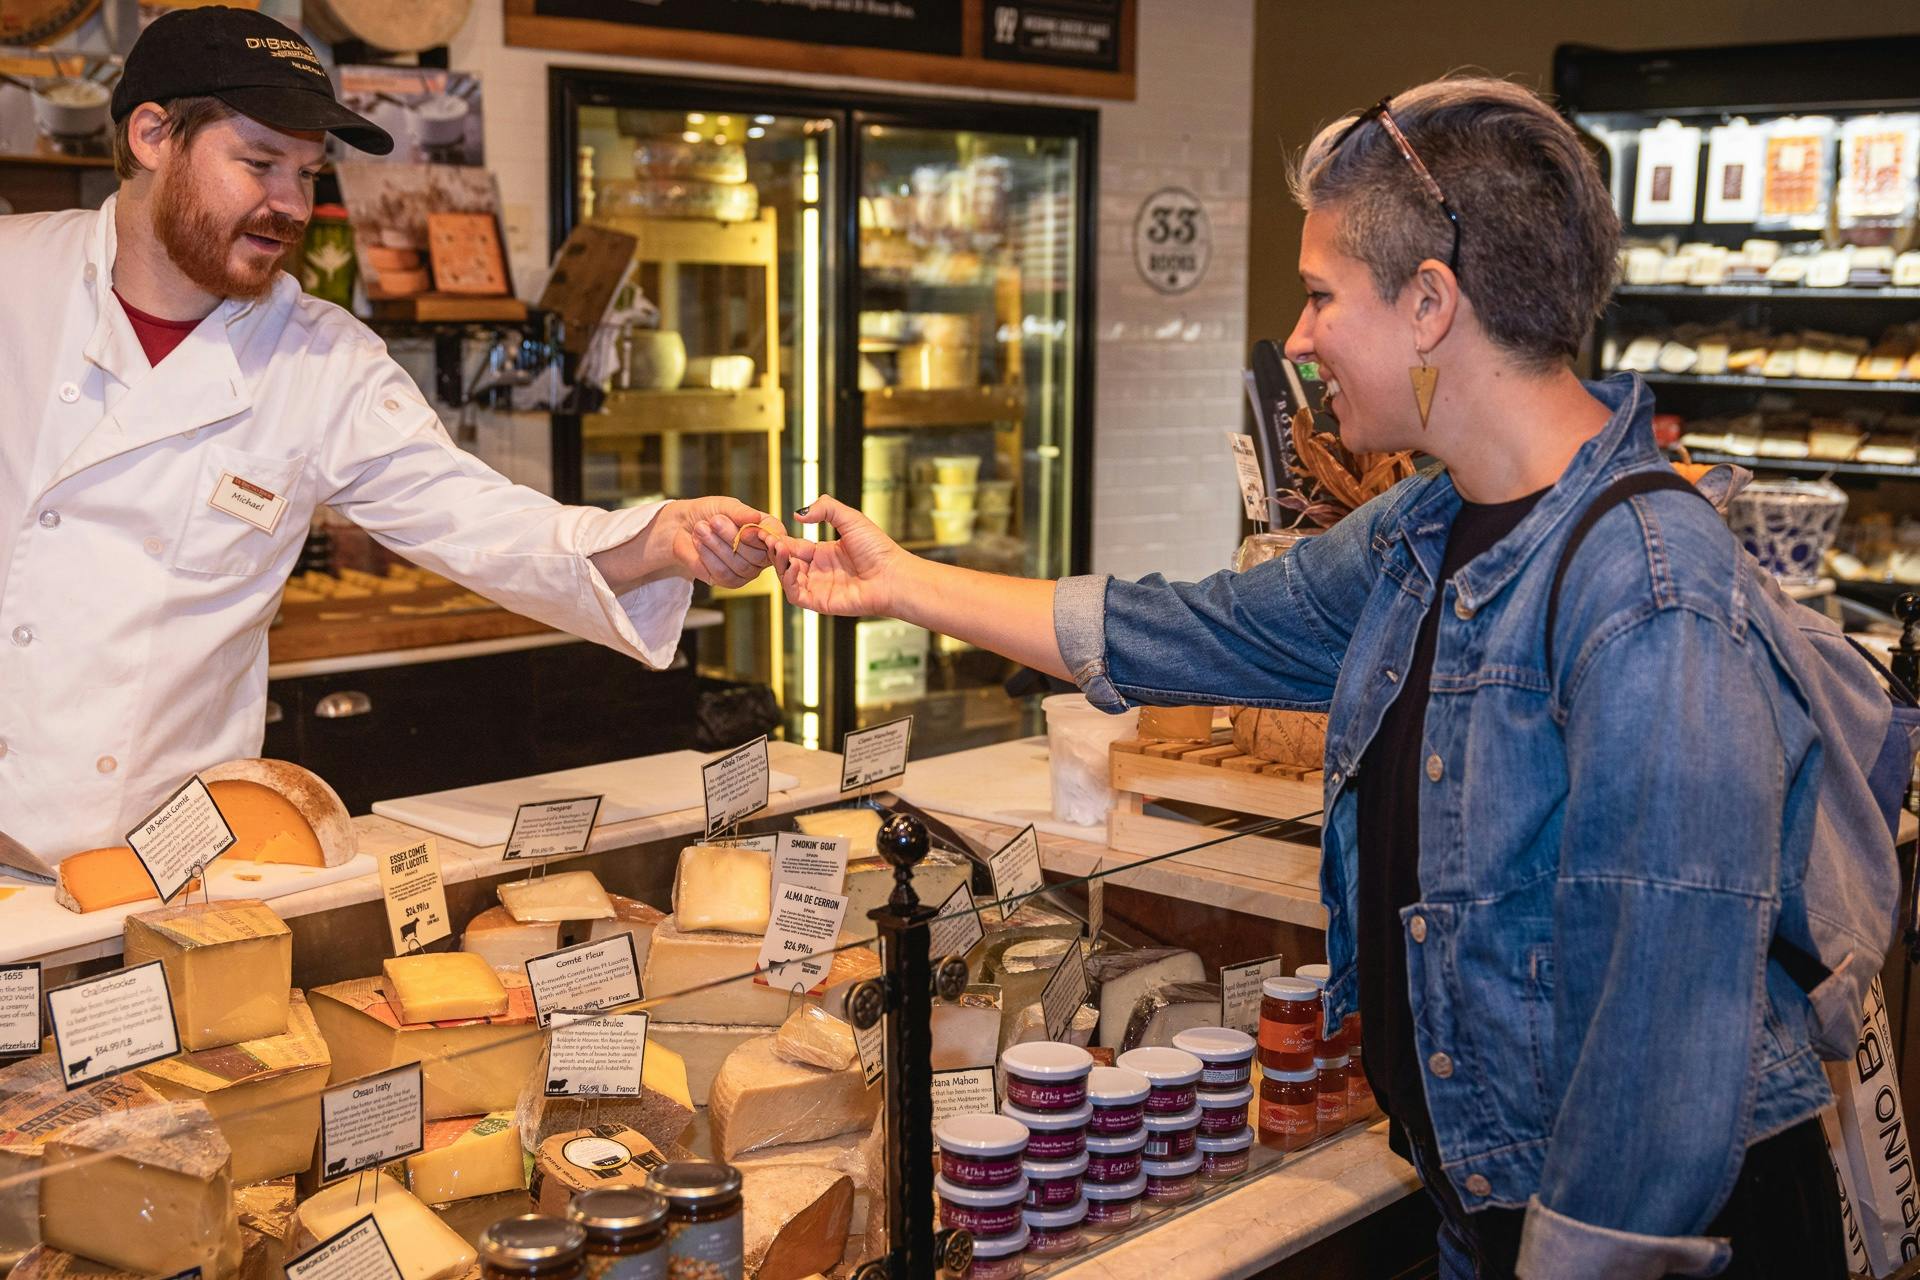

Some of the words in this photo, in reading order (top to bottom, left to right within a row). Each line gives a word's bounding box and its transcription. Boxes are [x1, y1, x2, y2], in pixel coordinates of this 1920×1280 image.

[1147, 206, 1201, 245] 33
[231, 492, 265, 511] Michael
[145, 823, 155, 835] DB
[154, 809, 171, 827] Select
[170, 793, 189, 813] Comté
[212, 834, 229, 851] France
[791, 839, 820, 850] SMOKIN'
[820, 842, 837, 851] GOAT
[389, 851, 407, 864] ESSEX
[390, 862, 404, 875] FORT
[405, 853, 428, 869] LUCOTTE
[784, 889, 803, 902] ALMA
[803, 894, 813, 904] DE
[784, 939, 812, 954] $24.99/LB
[556, 954, 581, 968] Comté
[585, 948, 604, 960] Fleur
[3, 971, 23, 981] 1655
[539, 985, 550, 993] This
[551, 980, 573, 991] younger
[574, 972, 592, 983] Comté
[604, 963, 629, 975] surprising
[17, 985, 34, 993] Super
[555, 988, 567, 996] with
[598, 975, 608, 983] and
[608, 990, 629, 1002] France
[0, 1040, 36, 1050] witzerland
[601, 1083, 609, 1091] lb
[952, 1075, 979, 1086] Mahon
[353, 1084, 372, 1099] Ossau
[376, 1079, 390, 1094] Iraty
[1031, 1090, 1046, 1101] Eat
[1045, 1090, 1060, 1101] This
[1092, 1113, 1103, 1123] his
[395, 1140, 412, 1152] France
[956, 1166, 969, 1177] Eat
[969, 1167, 986, 1177] This
[1110, 1163, 1124, 1172] Eat
[950, 1212, 963, 1222] Eat
[962, 1213, 978, 1225] This
[1041, 1236, 1057, 1246] This
[296, 1252, 330, 1276] SMOKED
[329, 1226, 369, 1255] RACLETTE
